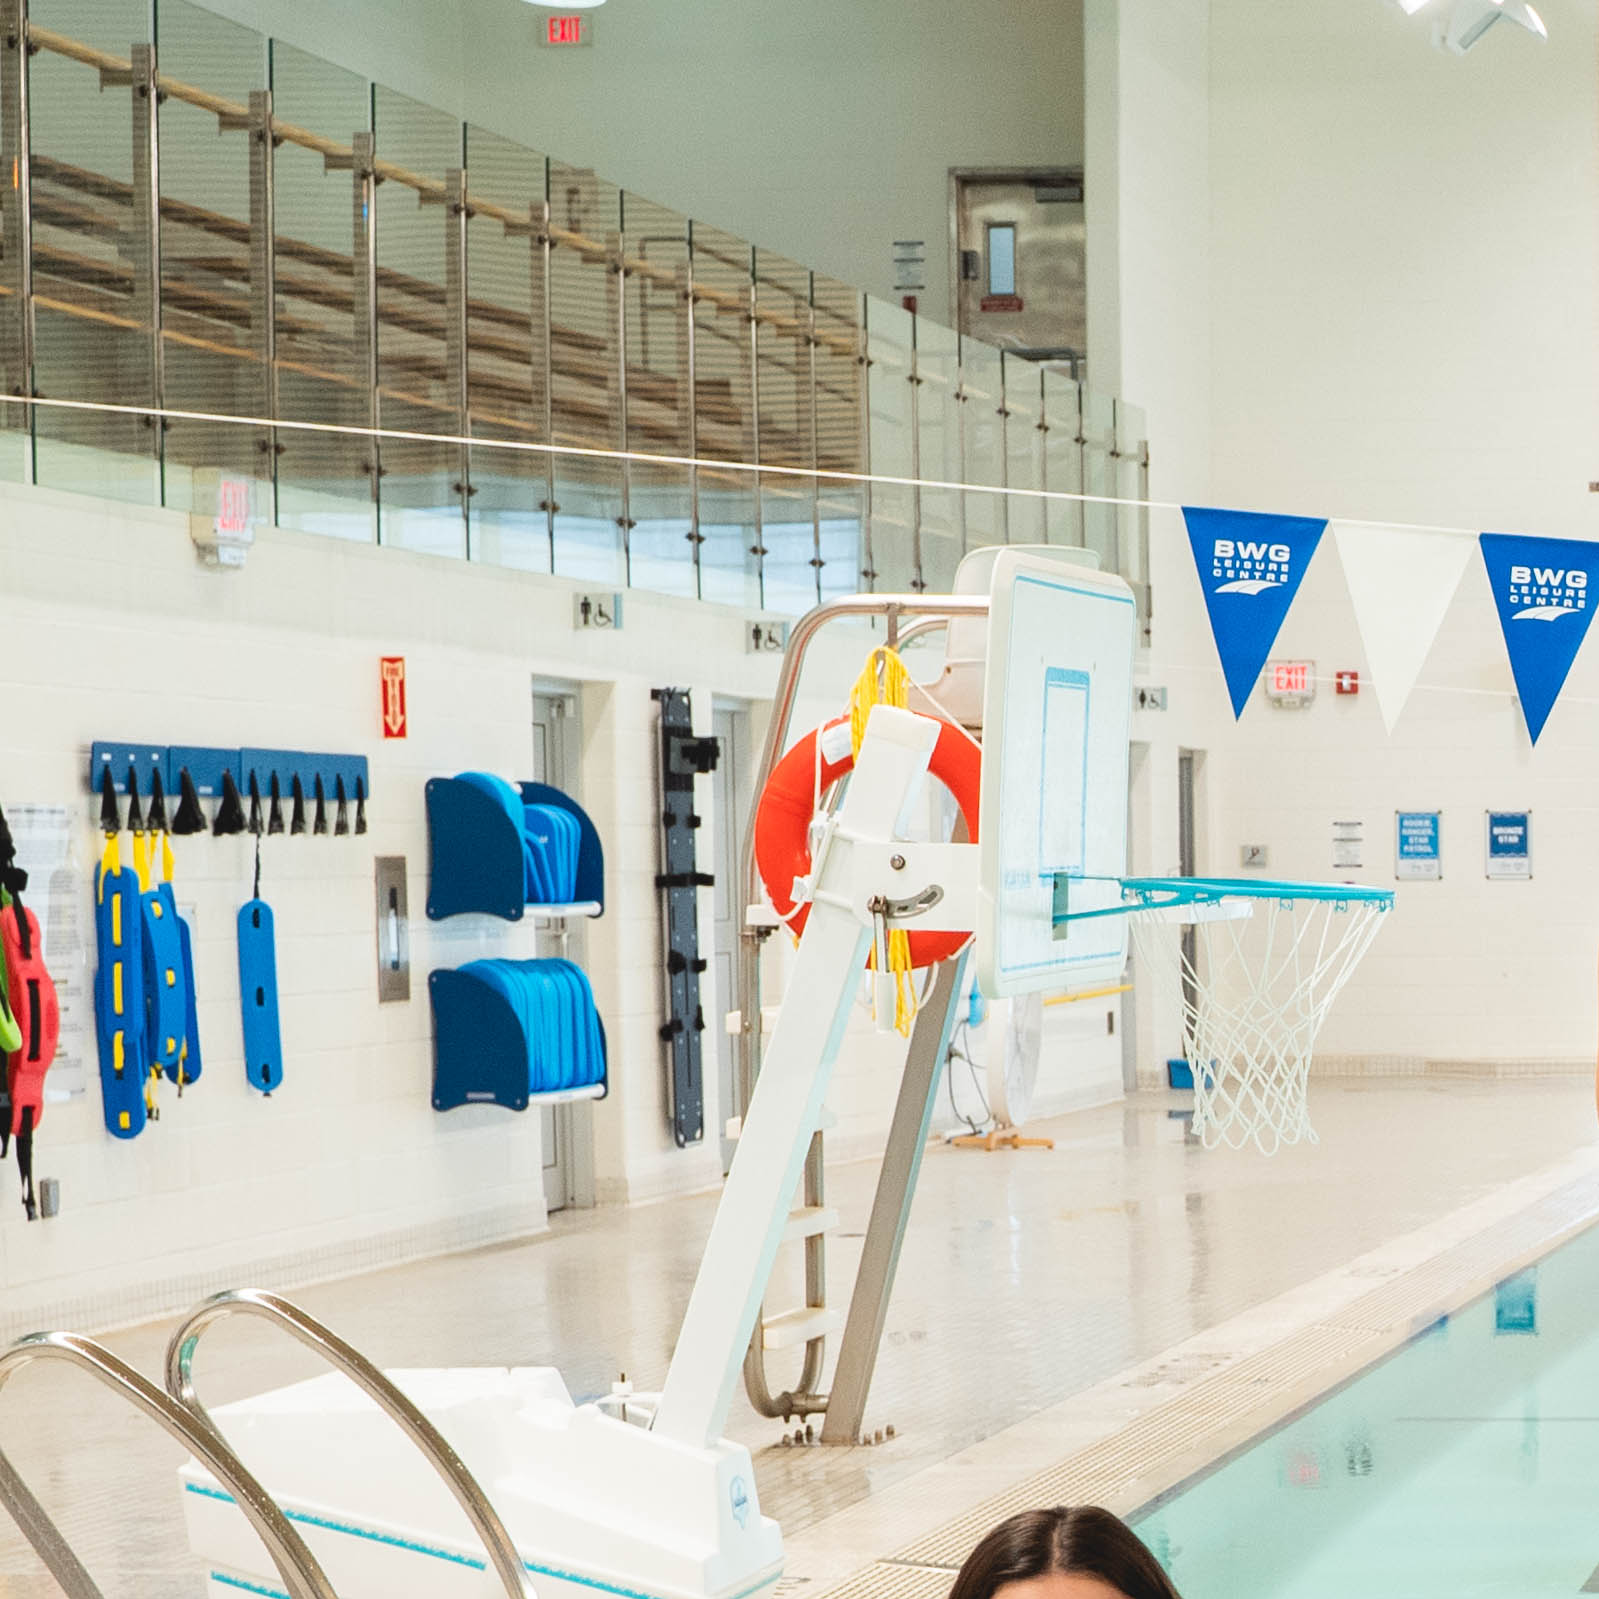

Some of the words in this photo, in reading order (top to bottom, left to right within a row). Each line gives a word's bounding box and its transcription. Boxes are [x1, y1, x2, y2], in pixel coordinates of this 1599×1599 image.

[548, 16, 581, 43] EXIT
[221, 480, 248, 531] EXIT
[1214, 539, 1290, 562] BWG
[1213, 558, 1289, 572] LEISURE
[1213, 568, 1288, 582] CENTRE
[1511, 565, 1588, 588] BWG
[1509, 595, 1586, 608] CENTRE
[1510, 585, 1586, 598] LEISURE
[1275, 665, 1307, 690] EXIT
